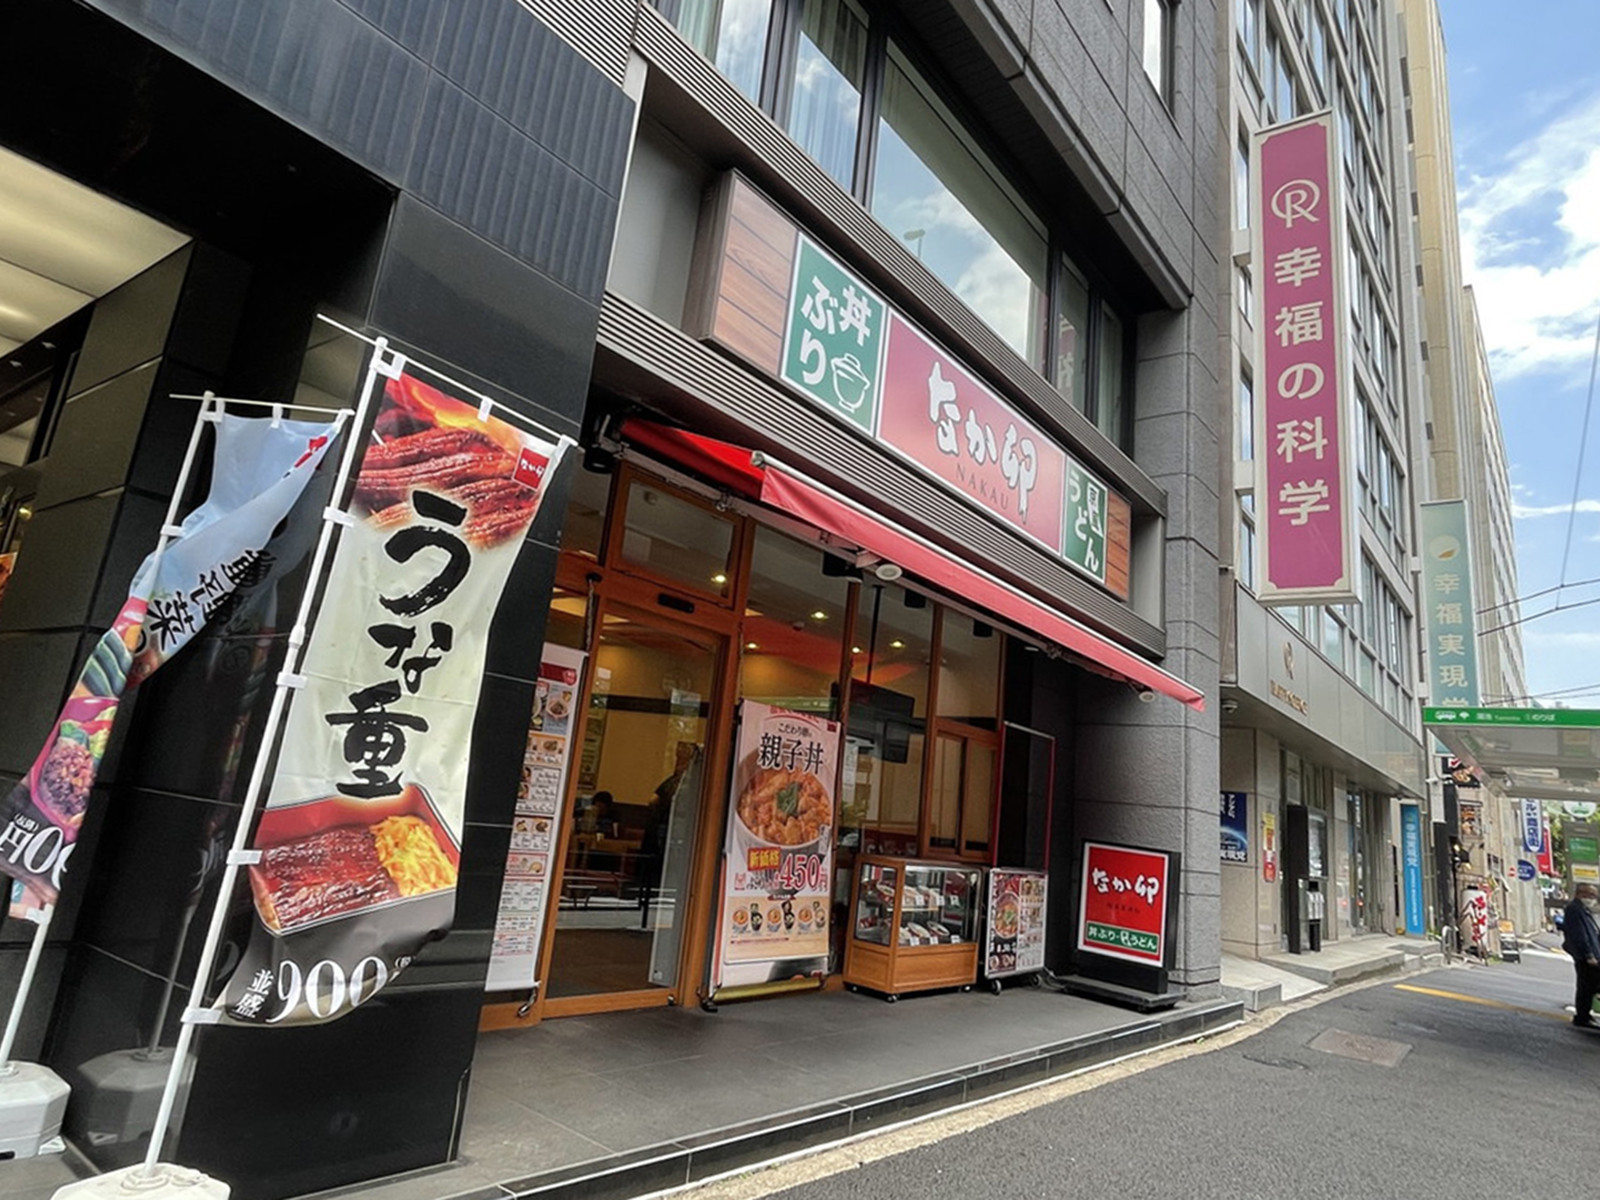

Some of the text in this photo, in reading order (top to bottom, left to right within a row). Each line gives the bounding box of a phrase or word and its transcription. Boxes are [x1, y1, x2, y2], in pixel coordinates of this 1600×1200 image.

[1275, 246, 1331, 526] 幸福の科学
[956, 463, 1010, 510] NAKAU
[325, 489, 472, 799] うな重
[759, 732, 825, 775] 親子丼
